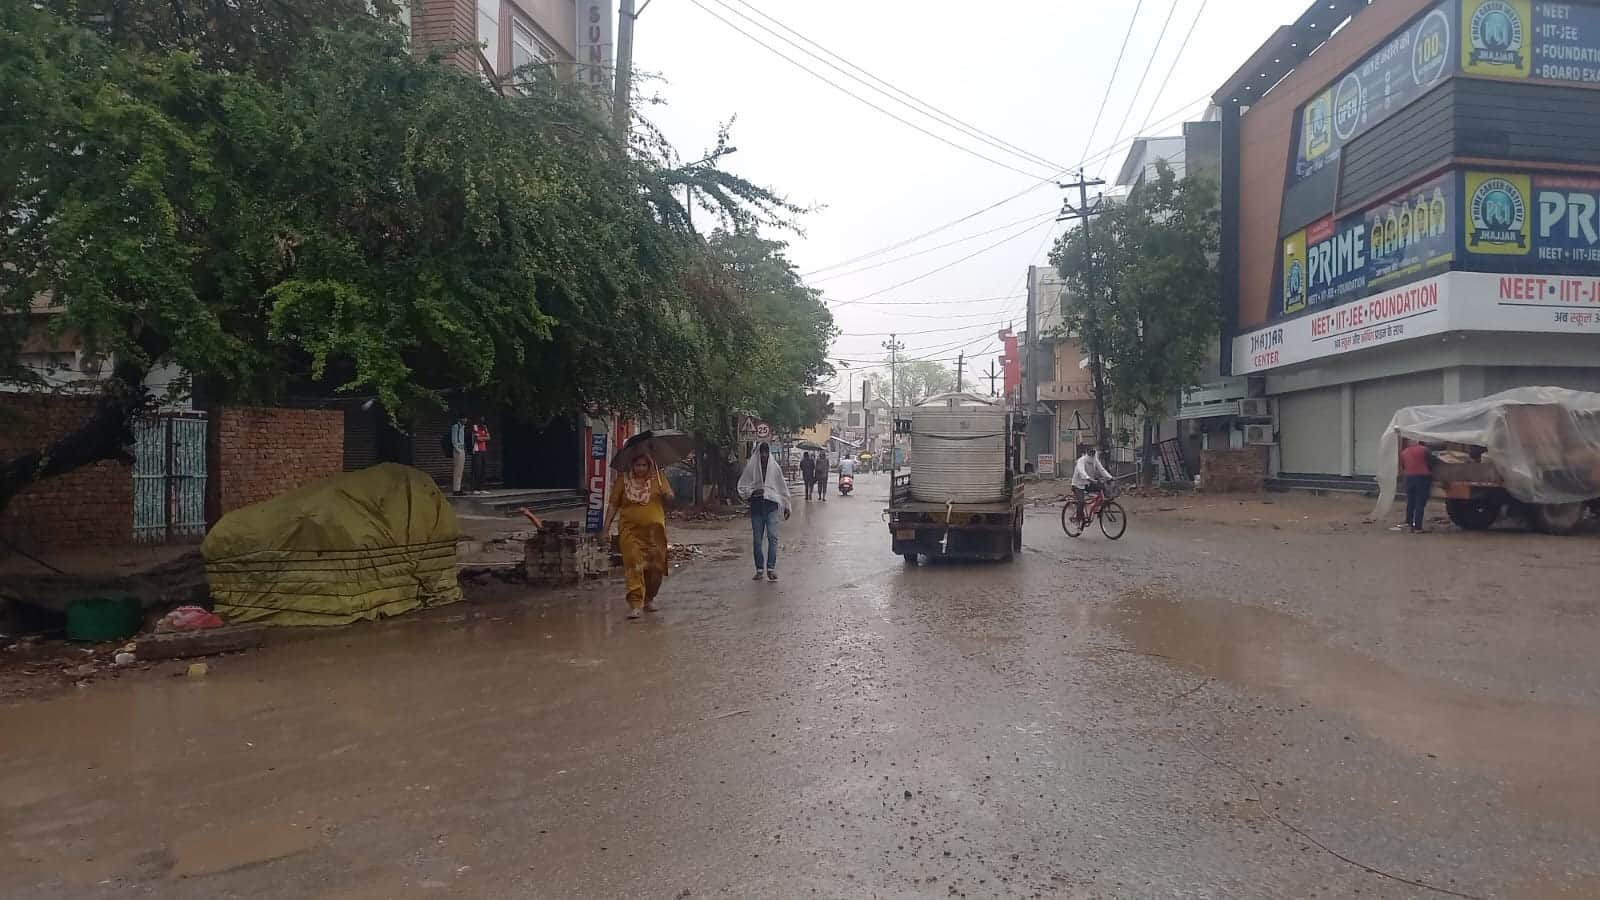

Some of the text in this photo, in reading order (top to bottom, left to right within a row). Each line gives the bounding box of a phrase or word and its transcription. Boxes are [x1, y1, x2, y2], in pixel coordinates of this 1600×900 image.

[1542, 4, 1570, 19] NEET
[1542, 23, 1578, 41] IIT-JEE
[1418, 31, 1440, 66] 100
[1542, 64, 1581, 81] BOARD
[1538, 191, 1600, 245] PR
[1480, 231, 1517, 242] JHAJJAR
[1308, 224, 1366, 287] PRIME
[1538, 247, 1563, 260] NEET
[1499, 277, 1547, 300] NEET
[1311, 283, 1438, 337] NEET IIT-JEE FOUNDATION
[1570, 312, 1593, 328] स्कूल
[1250, 328, 1284, 354] JHAJJAR
[1254, 350, 1279, 368] CENTER
[758, 426, 768, 434] 25
